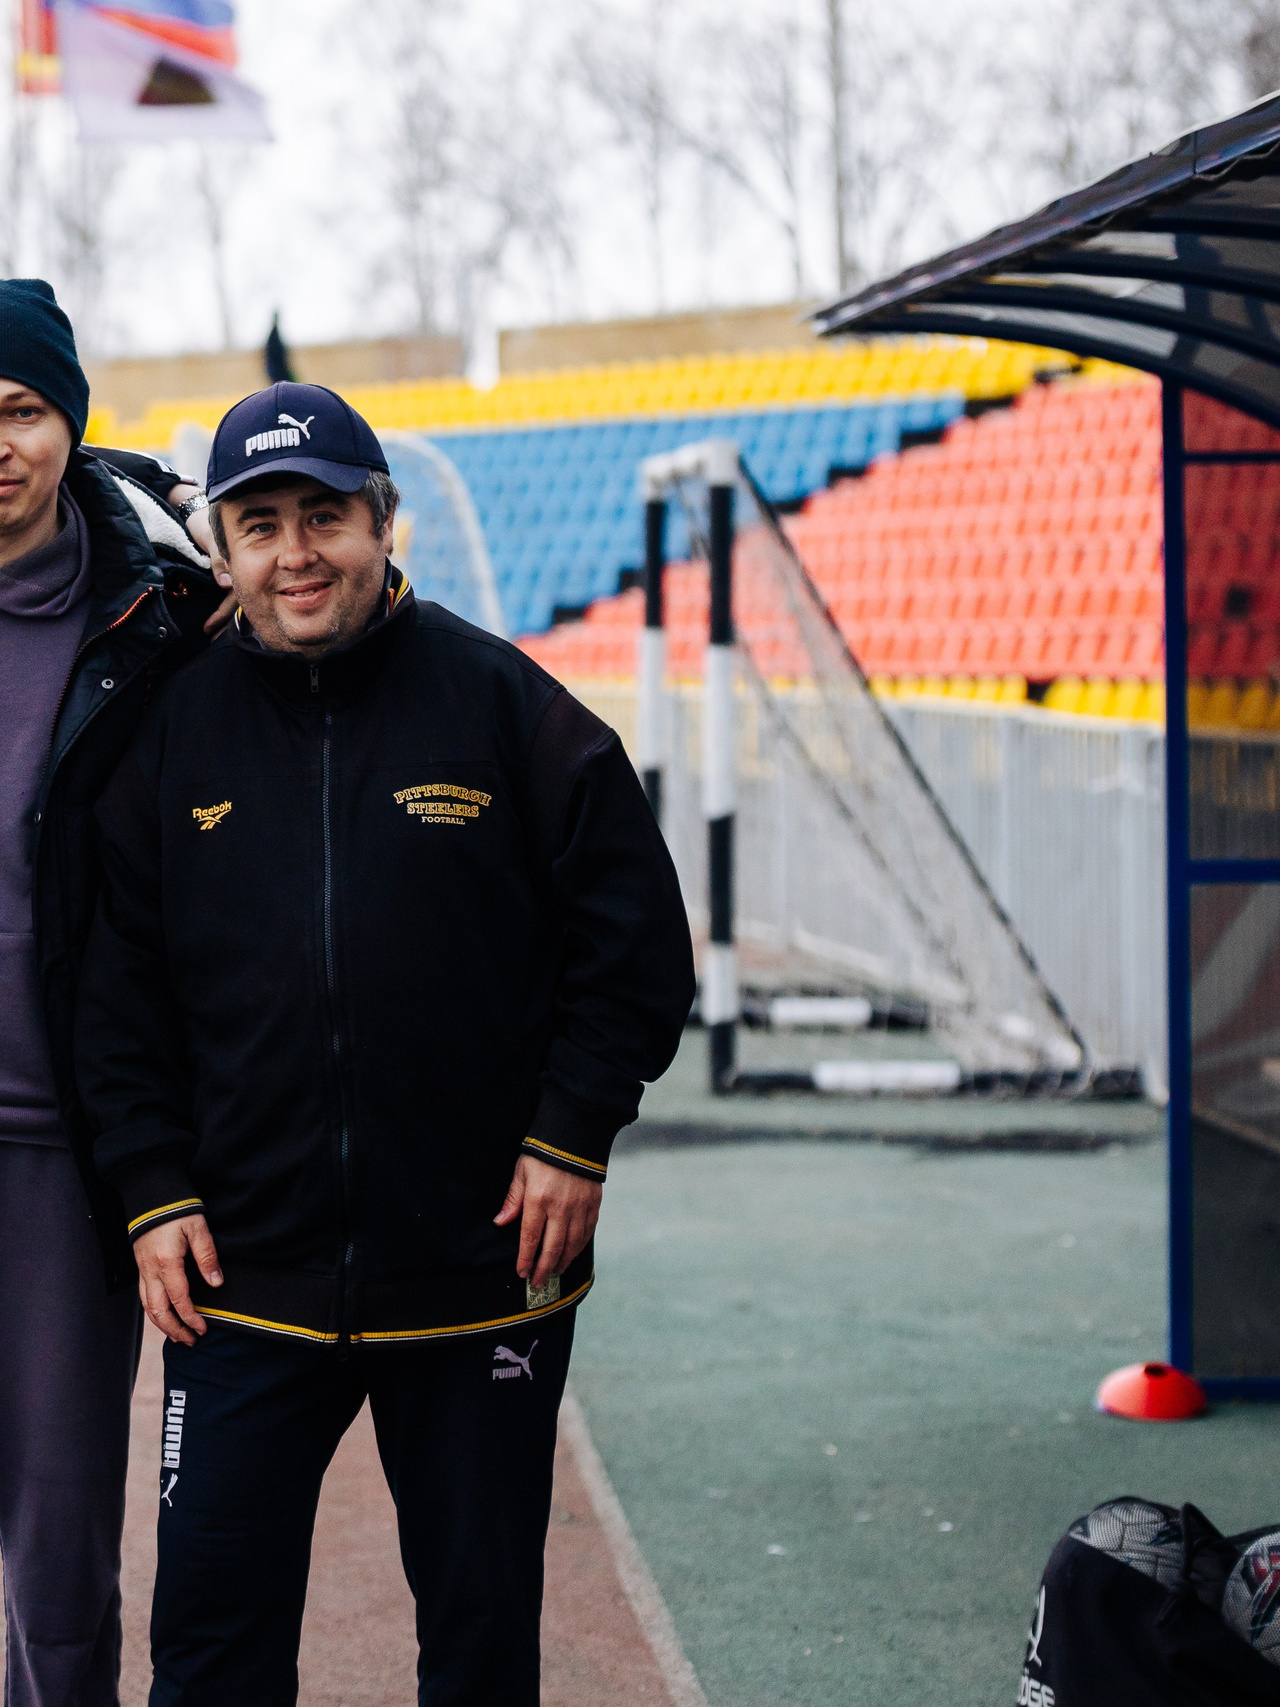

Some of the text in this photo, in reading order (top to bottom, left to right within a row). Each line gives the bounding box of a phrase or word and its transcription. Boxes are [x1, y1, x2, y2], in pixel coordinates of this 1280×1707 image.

[245, 428, 300, 457] PUMA
[393, 783, 492, 806] PITTSBURGH
[192, 800, 232, 820] Reebok
[406, 802, 480, 817] STEELERS
[421, 816, 466, 825] FOOTBALL
[492, 1366, 521, 1380] PUMA
[162, 1389, 186, 1468] PUMA
